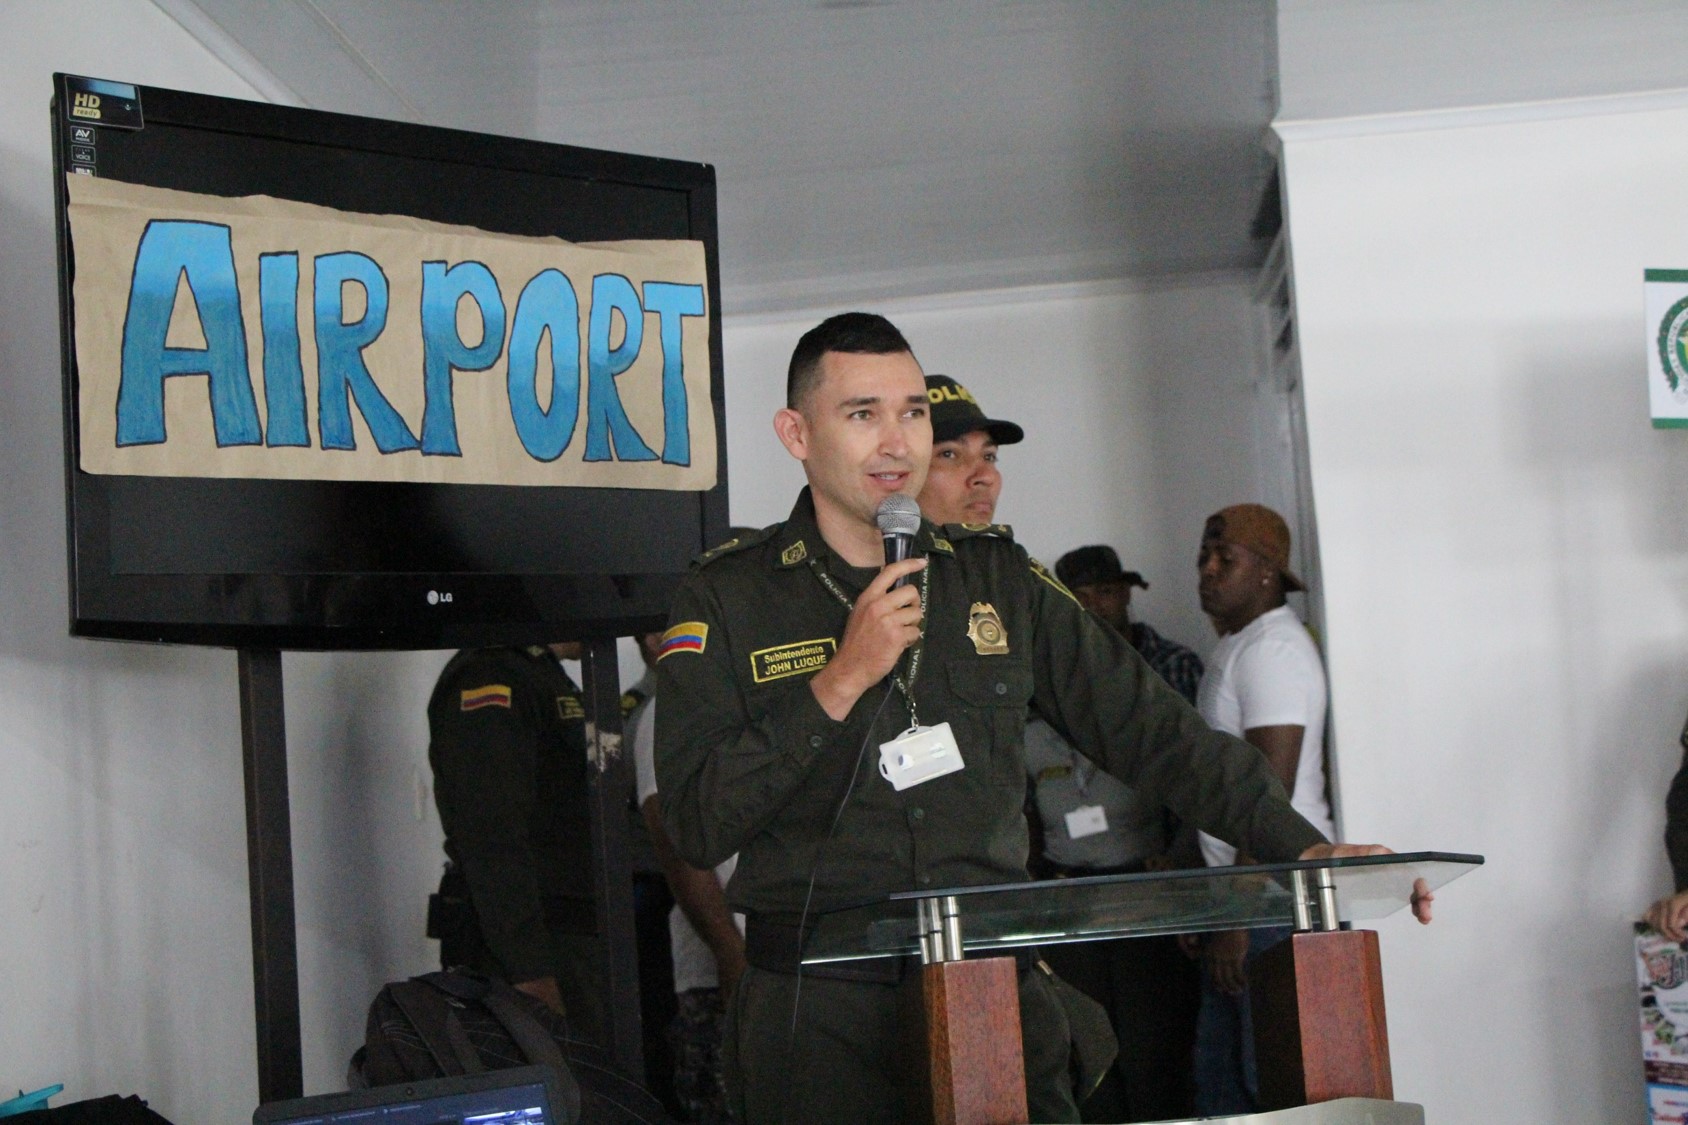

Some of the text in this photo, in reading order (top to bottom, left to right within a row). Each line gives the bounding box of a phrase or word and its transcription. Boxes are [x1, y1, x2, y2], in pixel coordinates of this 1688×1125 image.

[74, 93, 101, 107] HD
[75, 108, 99, 117] ready
[75, 129, 91, 138] AV
[115, 218, 706, 468] AIRPORT
[765, 654, 828, 675] JOHN LUQUE
